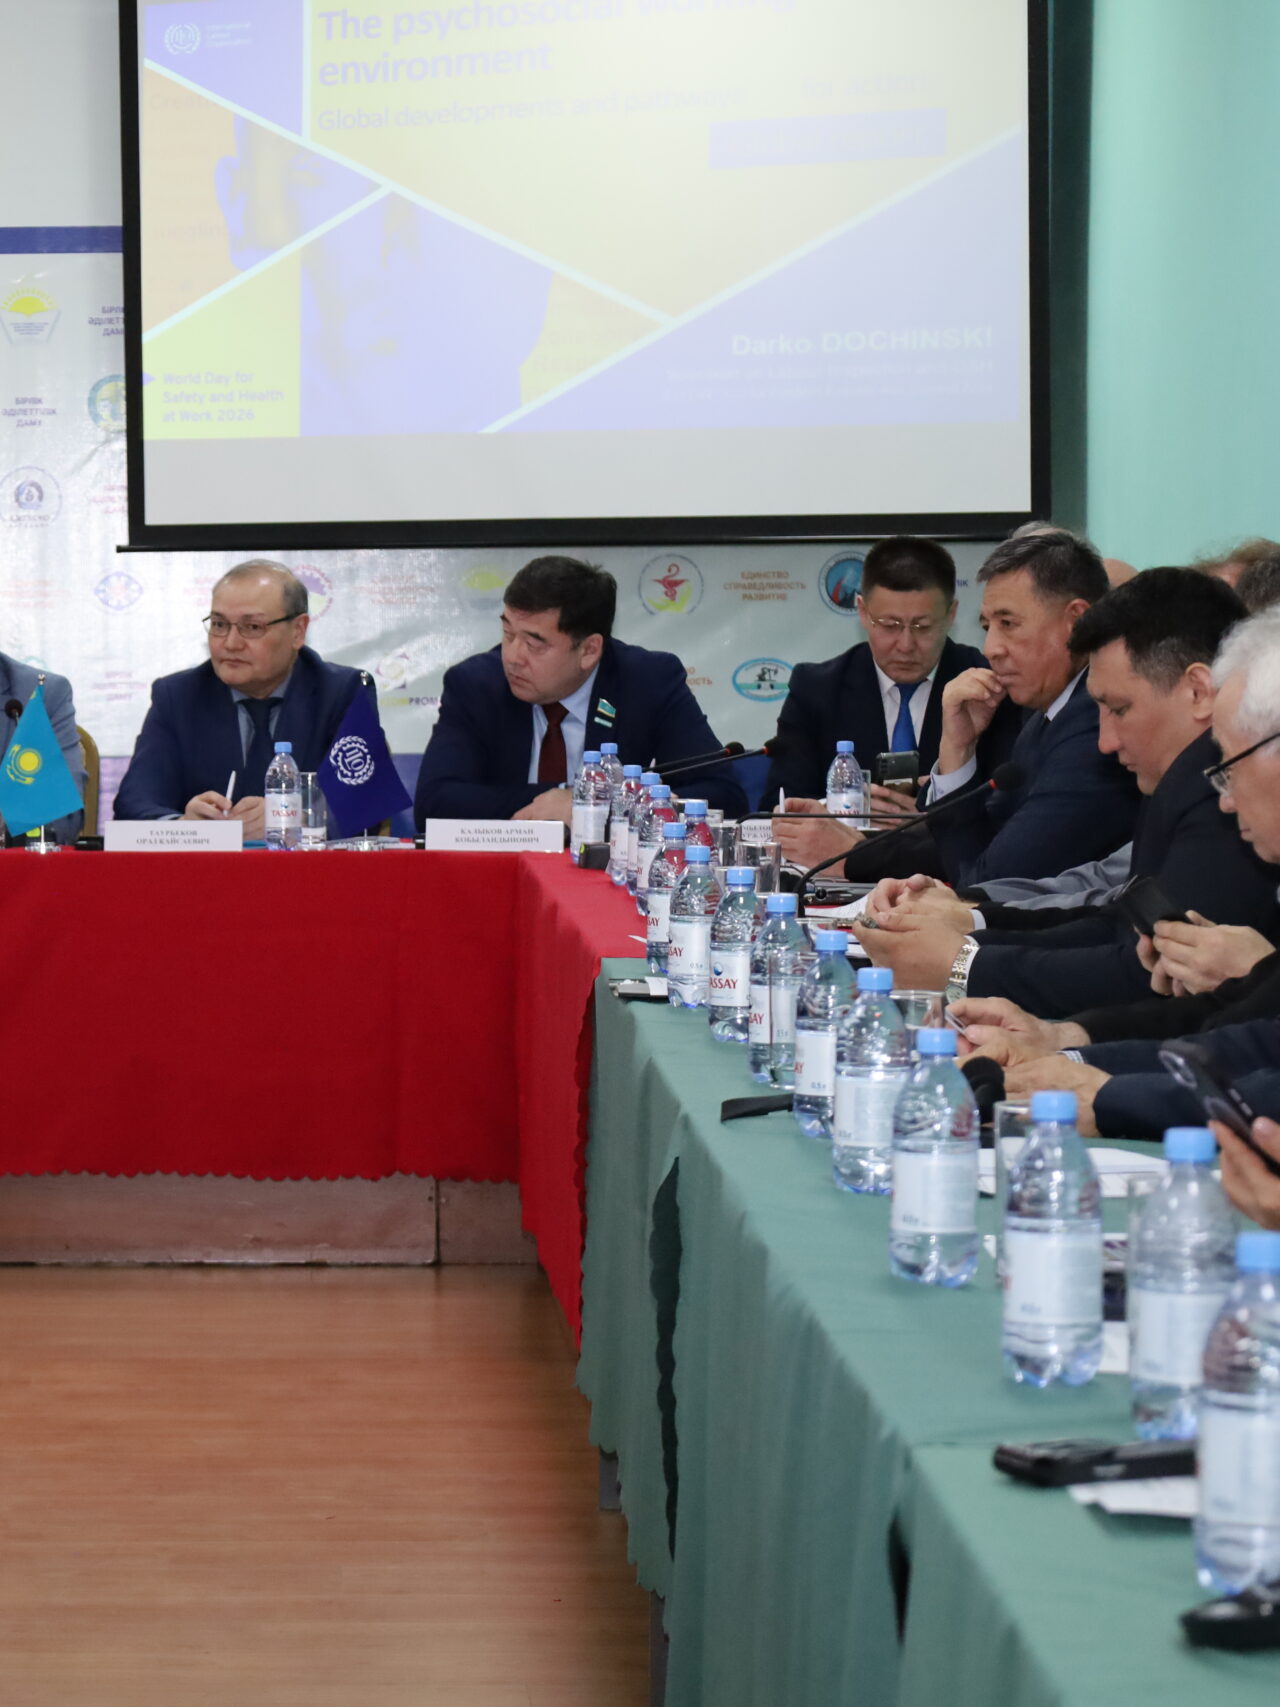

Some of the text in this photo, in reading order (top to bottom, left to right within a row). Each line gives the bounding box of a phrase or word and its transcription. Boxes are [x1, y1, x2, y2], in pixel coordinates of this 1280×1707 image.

[318, 9, 382, 41] The
[392, 0, 624, 44] psychosocial
[318, 44, 553, 86] environment
[317, 106, 389, 131] Global
[395, 98, 564, 129] developments
[731, 327, 993, 356] Darko DOCHINSKI
[163, 371, 255, 386] World Day for
[163, 388, 285, 405] Safety and Health
[162, 408, 255, 422] at Work 2026
[272, 809, 298, 818] TASSAY
